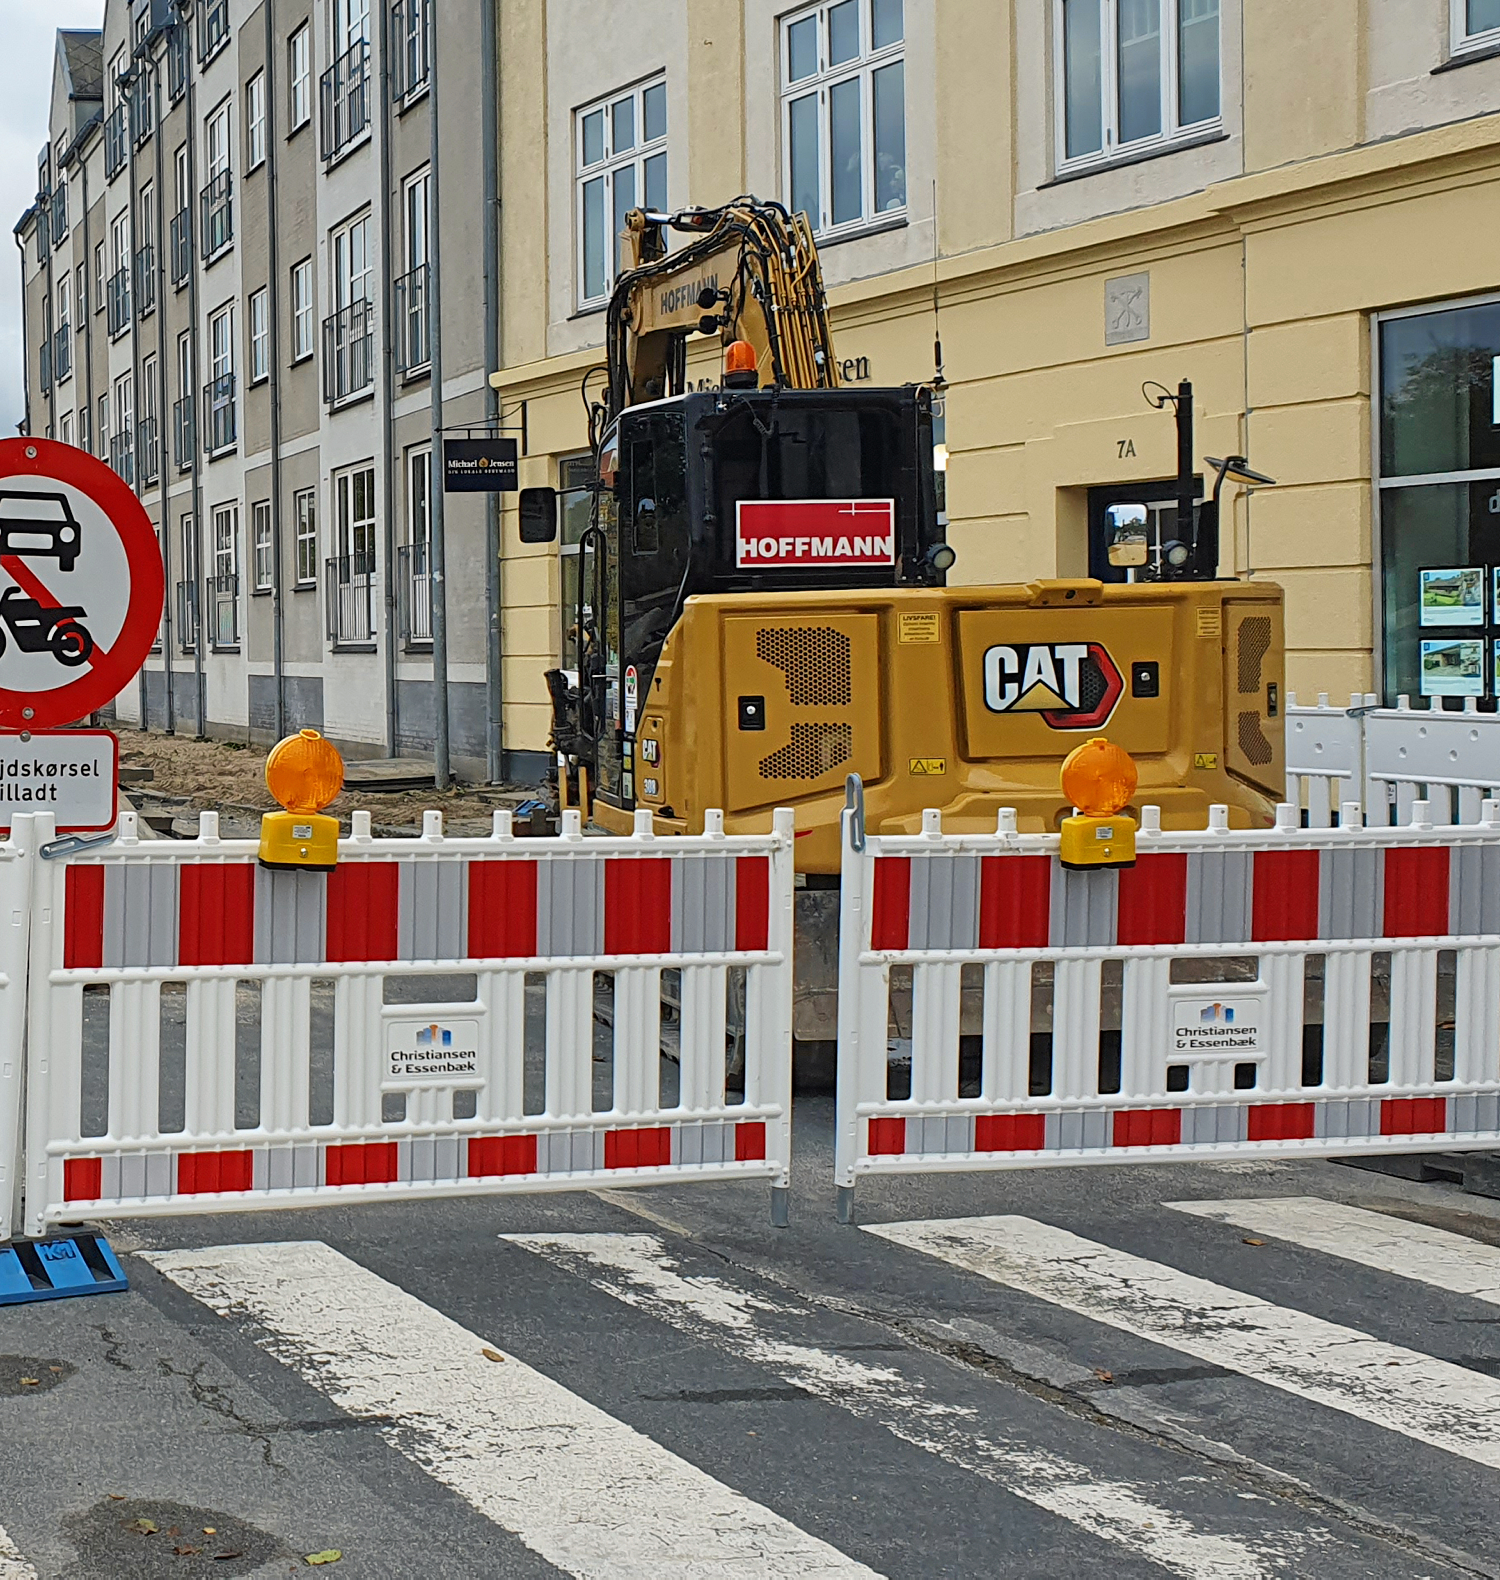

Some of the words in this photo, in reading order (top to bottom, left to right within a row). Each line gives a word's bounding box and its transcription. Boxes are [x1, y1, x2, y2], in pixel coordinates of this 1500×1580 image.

[1117, 439, 1137, 458] 7A
[448, 459, 478, 468] Michael
[489, 459, 515, 467] Jensen
[737, 536, 892, 558] HOFFMANN
[985, 645, 1088, 711] CAT
[1176, 1026, 1257, 1037] Christiansen
[1176, 1039, 1187, 1049] &
[1190, 1036, 1257, 1048] Essenbæk
[391, 1049, 476, 1061] Christiansen
[391, 1064, 402, 1074] &
[405, 1061, 476, 1074] Essenbæk
